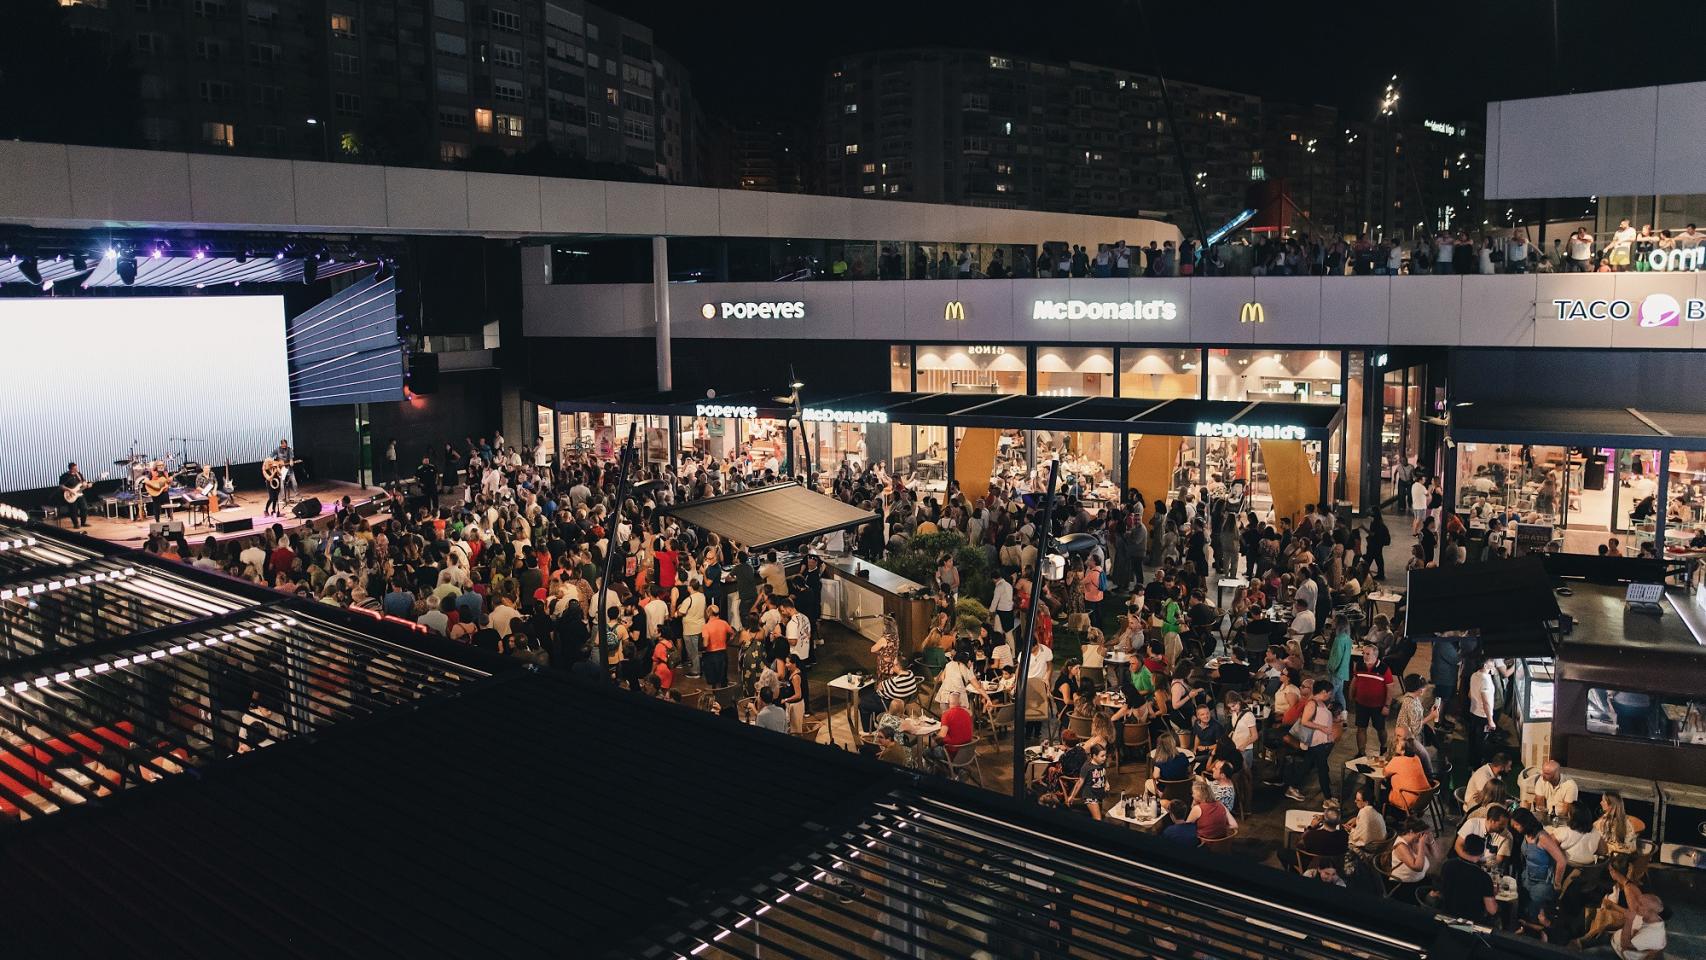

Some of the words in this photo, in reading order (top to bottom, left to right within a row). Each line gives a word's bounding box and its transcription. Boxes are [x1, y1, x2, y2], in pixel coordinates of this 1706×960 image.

[1033, 300, 1177, 320] McDonald's
[1553, 299, 1631, 320] TACO
[802, 408, 888, 423] McDonald's
[1195, 422, 1306, 440] McDonald's
